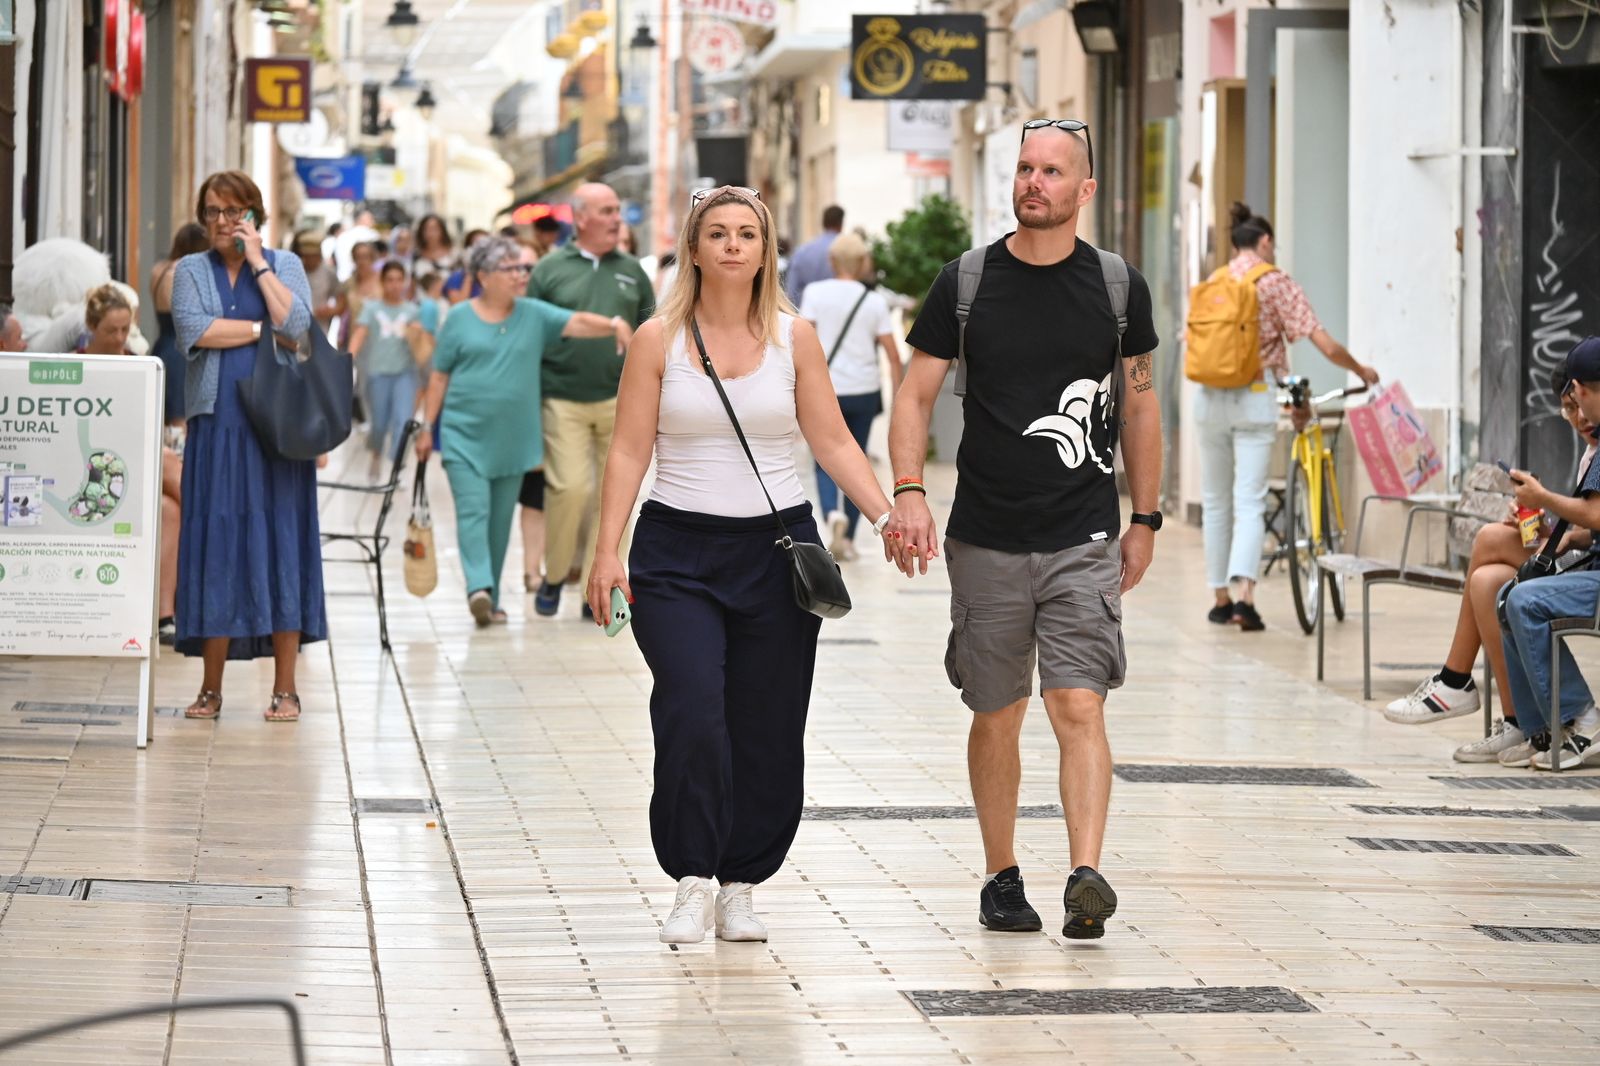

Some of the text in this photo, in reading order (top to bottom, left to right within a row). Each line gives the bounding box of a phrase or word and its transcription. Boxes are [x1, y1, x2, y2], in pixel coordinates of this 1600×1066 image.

[17, 396, 113, 417] DETOX
[0, 420, 59, 434] TURAL
[35, 548, 84, 557] PROACTIVA
[86, 550, 127, 558] NATURAL
